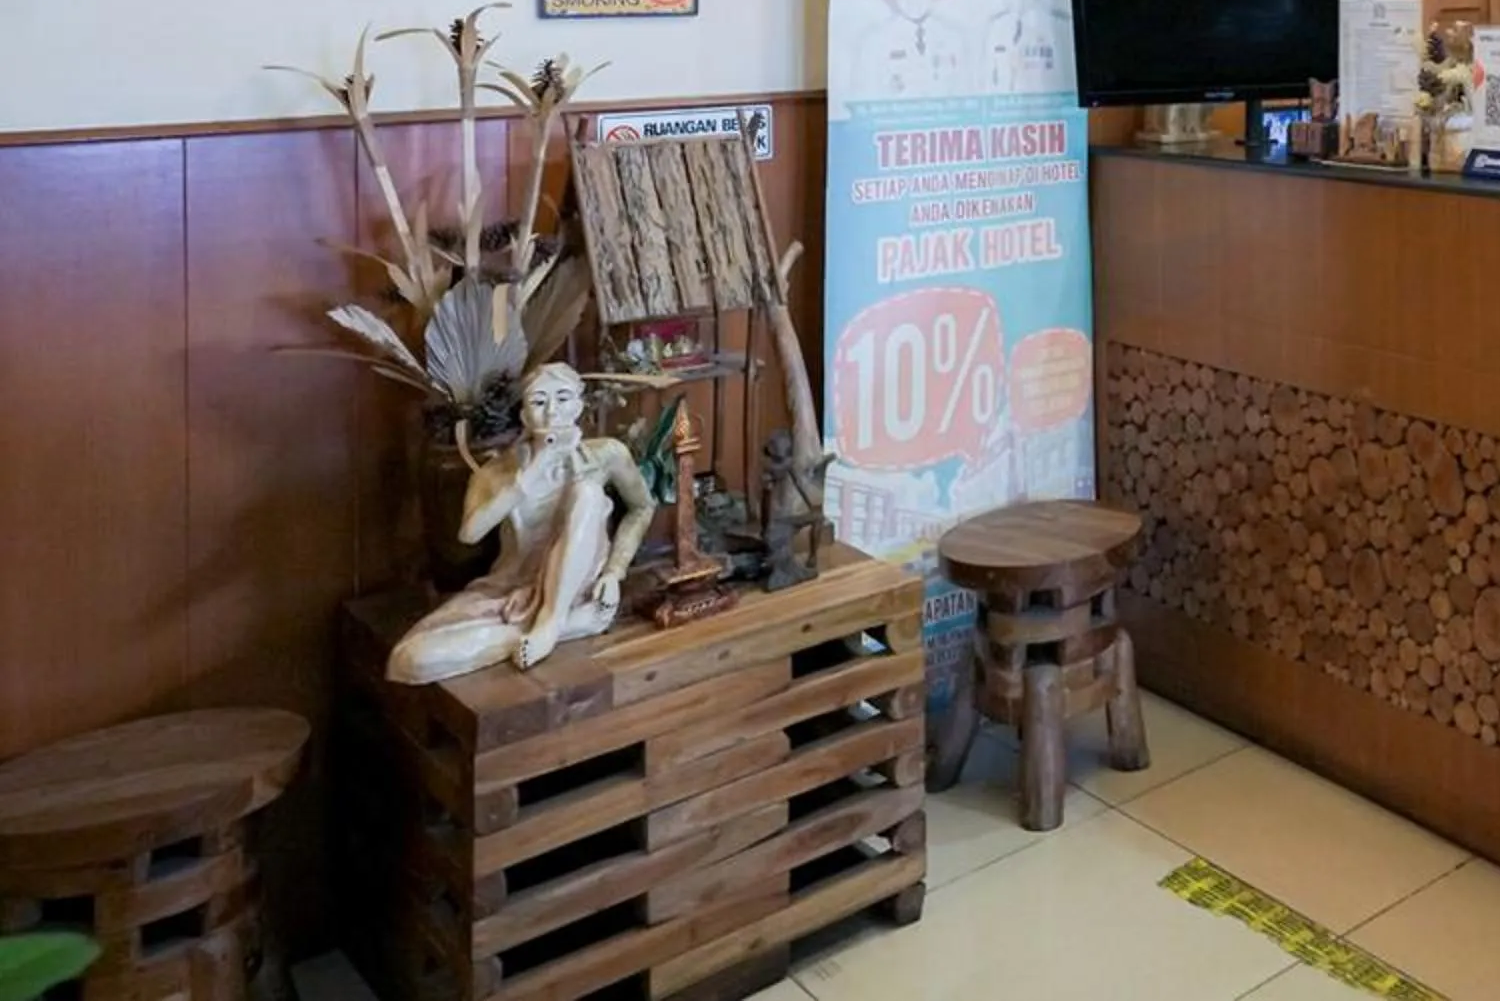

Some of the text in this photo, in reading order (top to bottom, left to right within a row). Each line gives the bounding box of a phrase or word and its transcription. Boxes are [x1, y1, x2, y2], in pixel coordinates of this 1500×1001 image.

[643, 118, 717, 137] RUANGAN
[876, 122, 1066, 168] TERIMA KASIH
[854, 177, 907, 202] SETIAP
[912, 172, 950, 195] ANDA
[1043, 162, 1081, 183] HOTEL
[911, 202, 950, 224] ANDA
[880, 221, 1059, 281] PAJAK HOTEL
[846, 306, 995, 450] 10%
